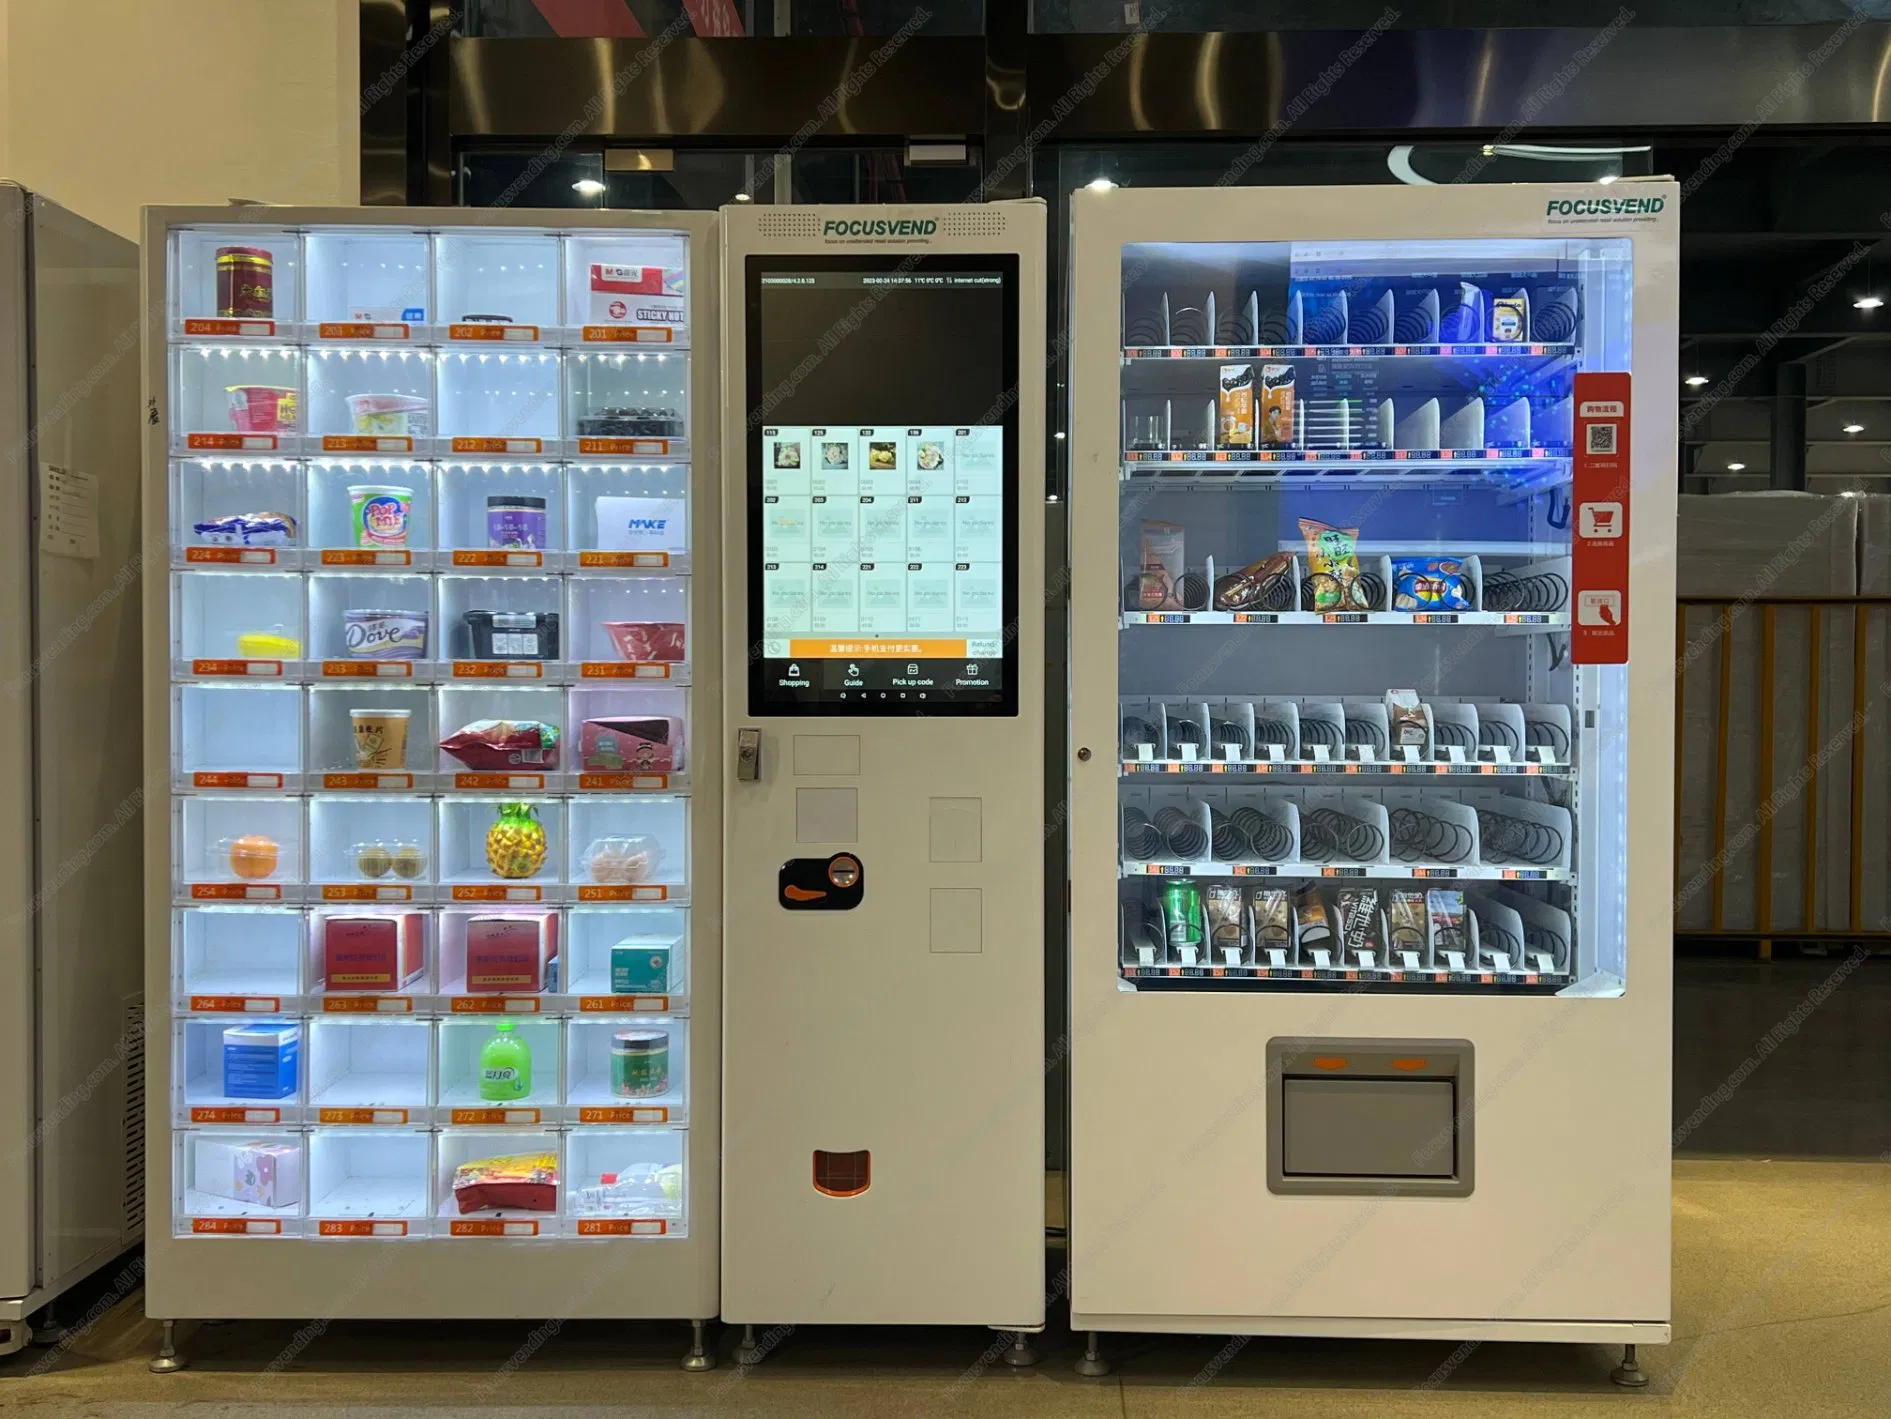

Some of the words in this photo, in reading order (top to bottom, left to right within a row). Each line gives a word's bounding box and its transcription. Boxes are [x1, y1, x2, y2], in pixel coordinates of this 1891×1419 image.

[1547, 198, 1664, 216] FOCUSVEND
[824, 220, 937, 236] FOCUSVEND
[637, 310, 666, 321] STICKY
[192, 324, 211, 332] 204
[590, 329, 607, 338] 201
[585, 442, 604, 450] 211
[628, 519, 666, 529] MAKE
[192, 551, 211, 559] 224
[458, 554, 477, 562] 222
[586, 555, 604, 564] 221
[348, 624, 401, 648] Dove
[327, 665, 346, 673] 233
[458, 666, 476, 674] 232
[587, 666, 605, 674] 231
[779, 679, 809, 687] Shopping
[199, 776, 218, 784] 244
[328, 777, 347, 785] 243
[461, 777, 479, 785] 242
[585, 778, 604, 786] 241
[327, 889, 346, 897] 253
[584, 889, 602, 898] 251
[456, 1001, 475, 1009] 262
[586, 1001, 604, 1009] 261
[197, 1111, 216, 1119] 274
[325, 1111, 343, 1120] 273
[457, 1112, 475, 1120] 272
[586, 1111, 604, 1120] 271
[199, 1222, 216, 1230] 284
[325, 1224, 343, 1233] 283
[456, 1224, 473, 1233] 282
[584, 1223, 601, 1232] 281
